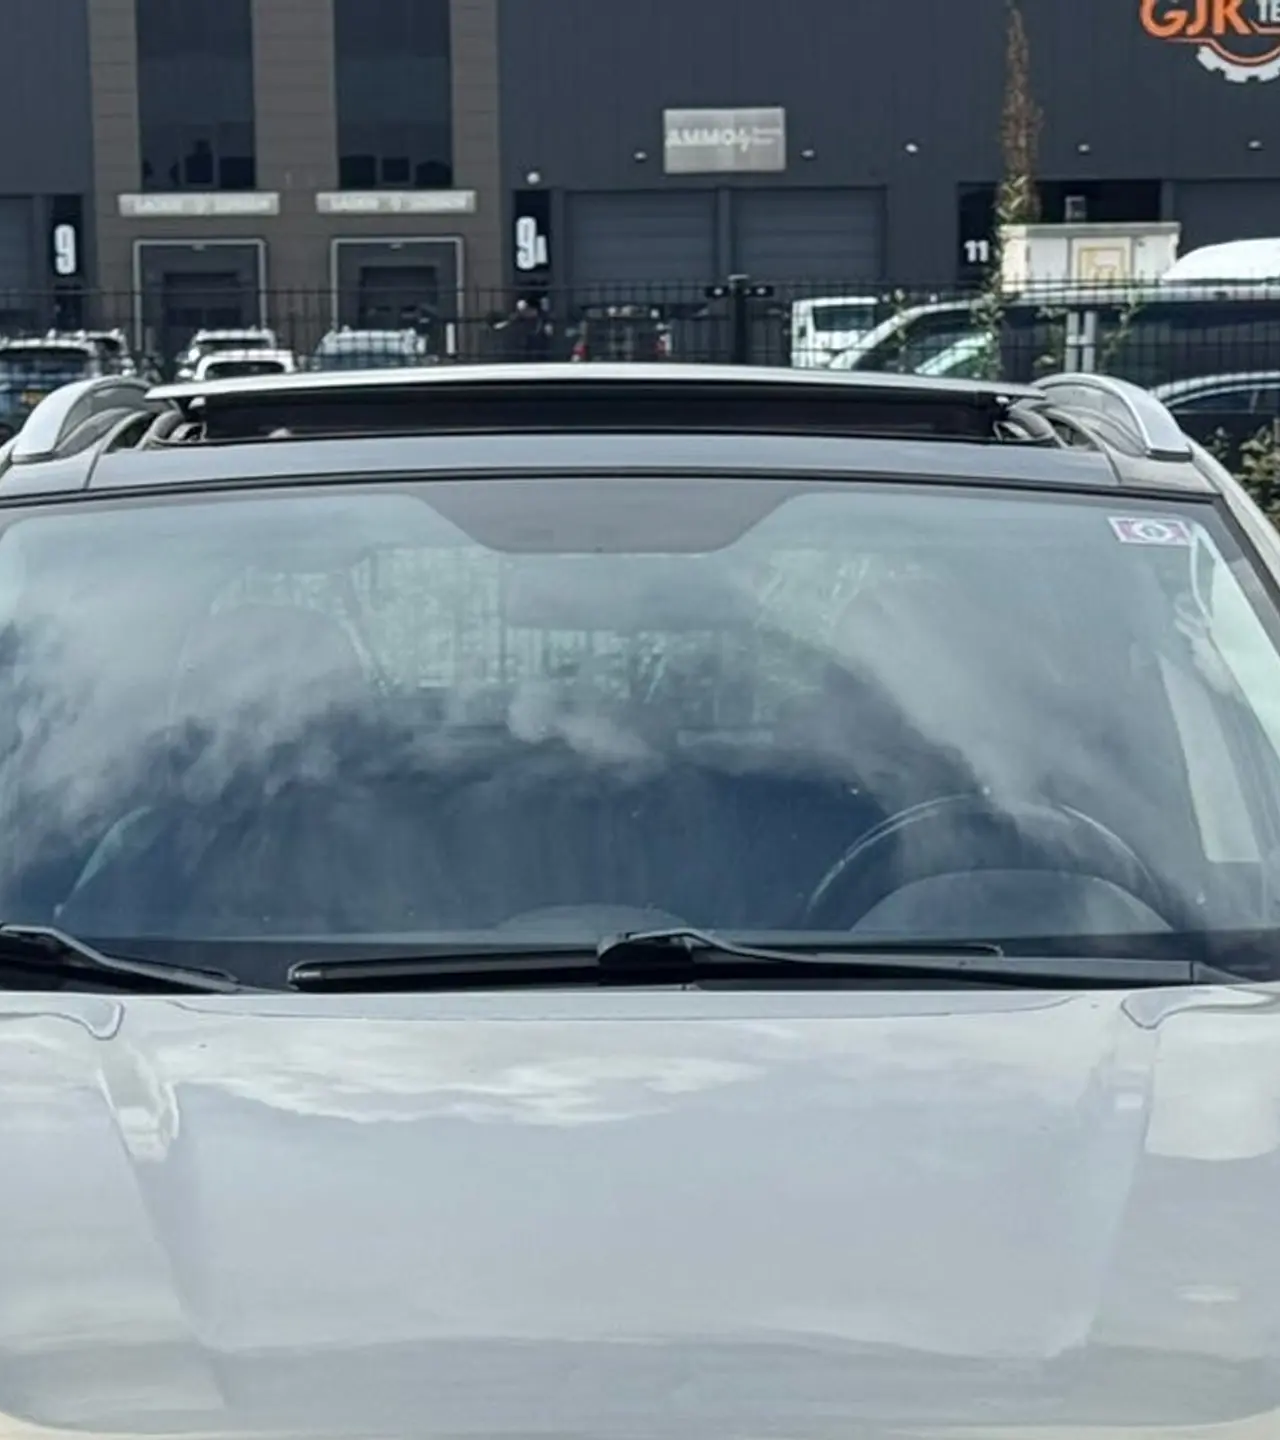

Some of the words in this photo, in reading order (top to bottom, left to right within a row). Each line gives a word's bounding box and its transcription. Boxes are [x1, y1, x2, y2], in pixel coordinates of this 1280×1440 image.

[1139, 0, 1252, 37] GJK
[54, 224, 76, 274] 9
[964, 240, 989, 262] 11
